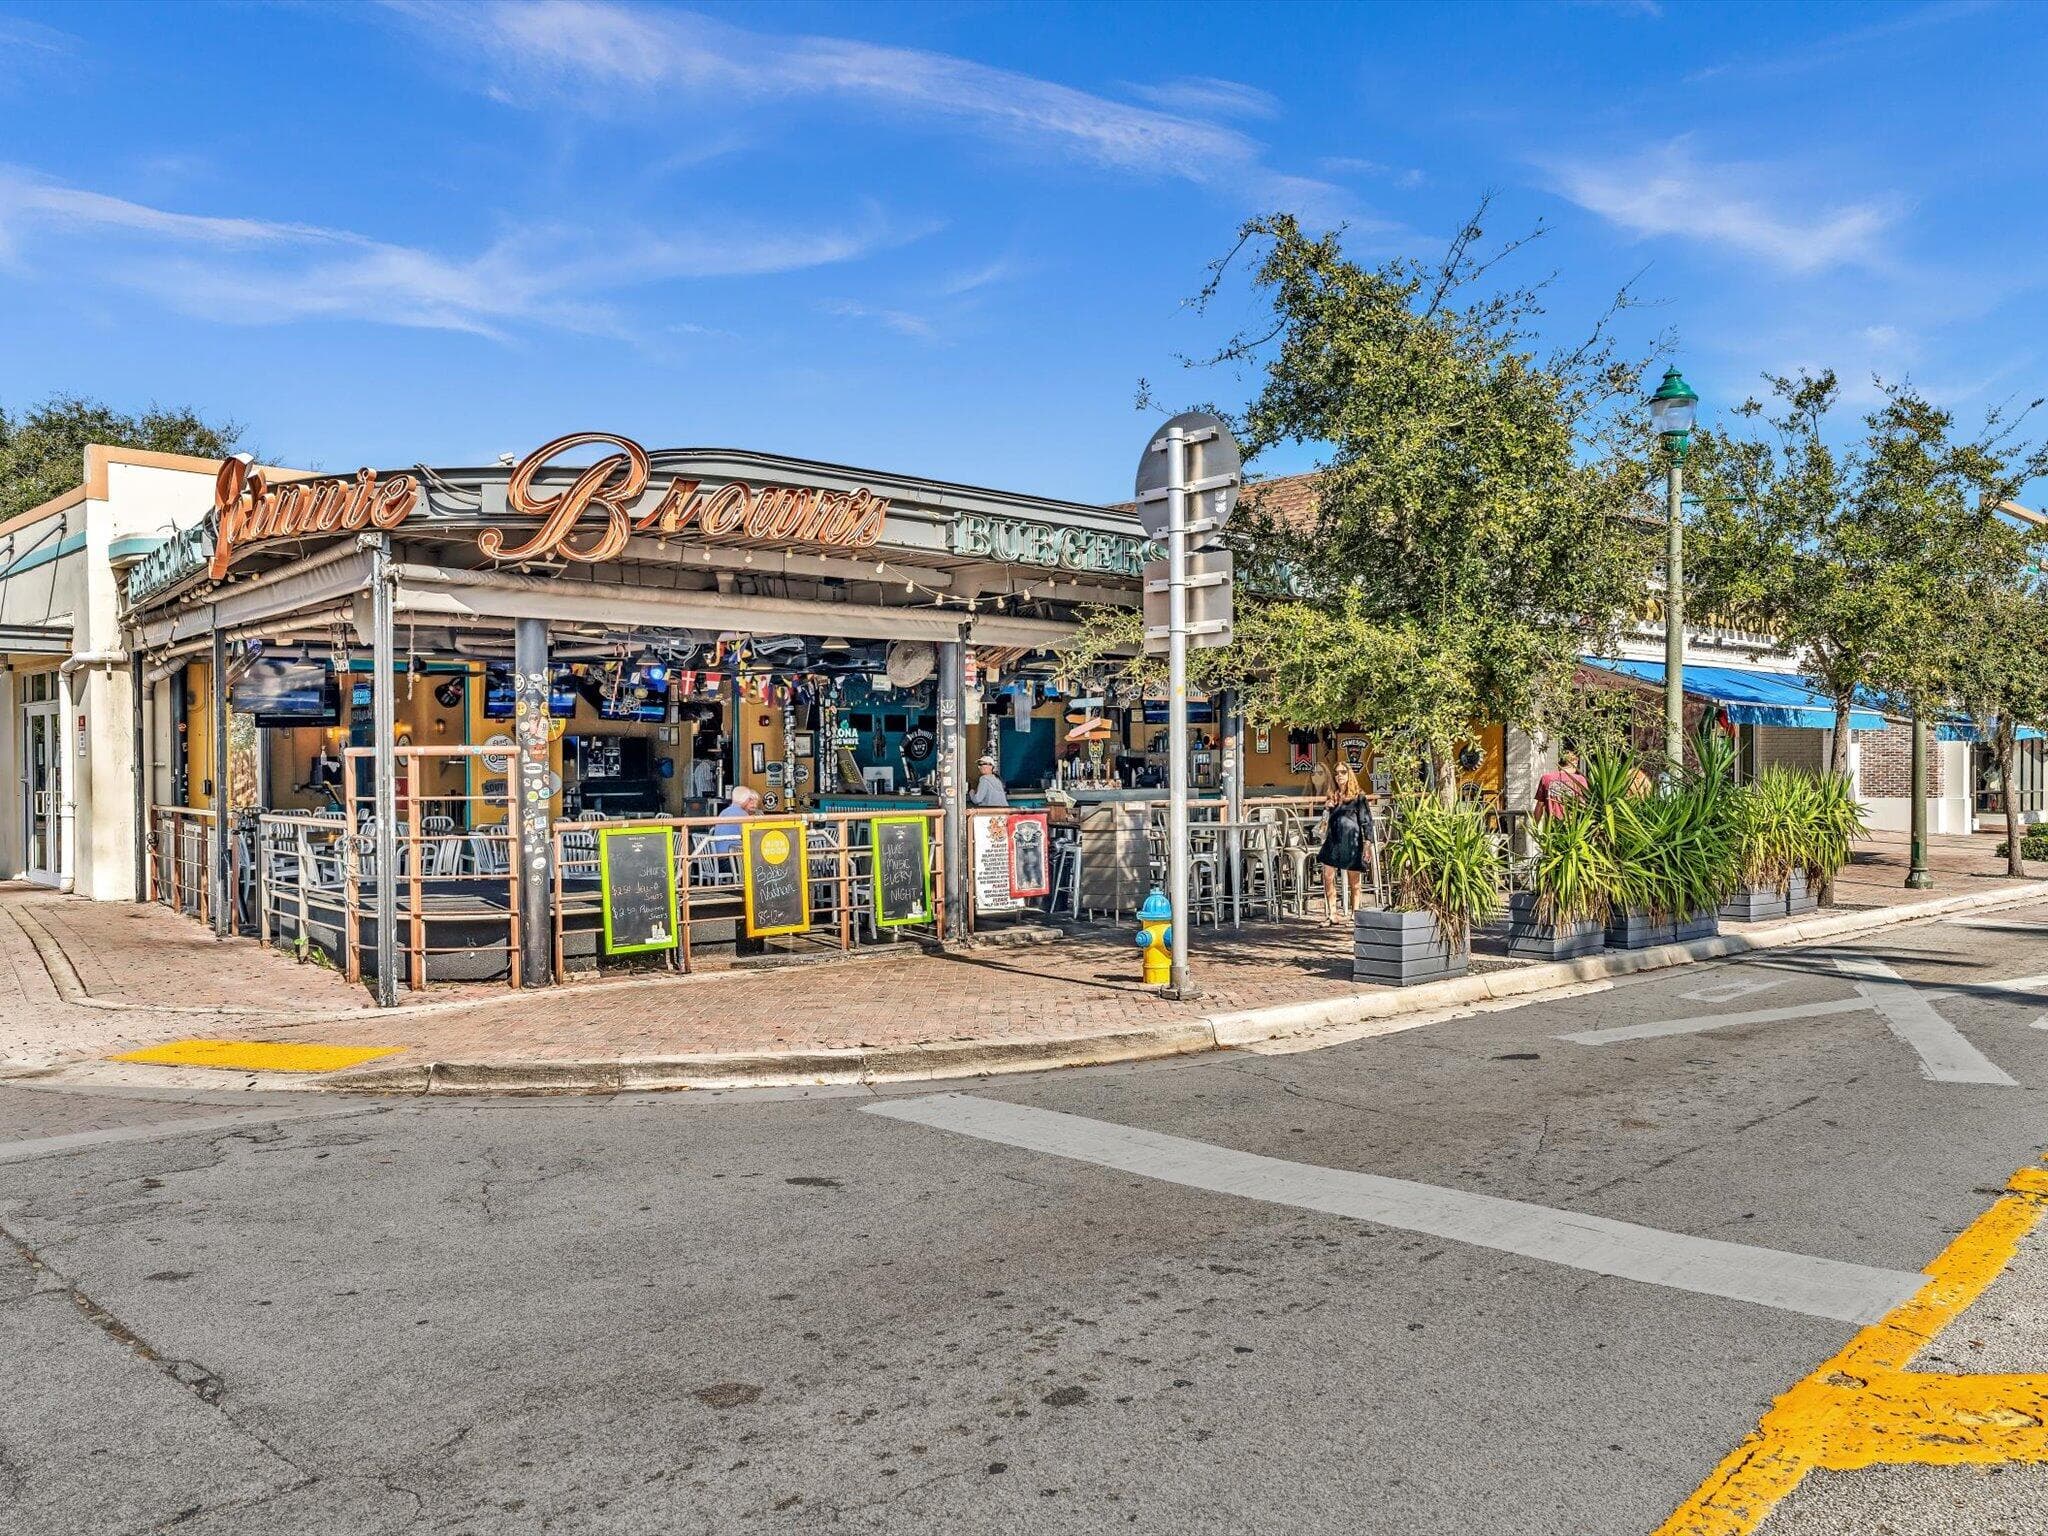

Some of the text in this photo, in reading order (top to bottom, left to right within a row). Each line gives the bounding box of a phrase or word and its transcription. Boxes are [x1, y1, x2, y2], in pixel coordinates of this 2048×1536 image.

[477, 431, 891, 563] Brown's
[836, 728, 859, 738] ONA
[881, 842, 905, 857] LIVE
[883, 870, 913, 887] EVERY
[890, 887, 918, 903] NIGHT
